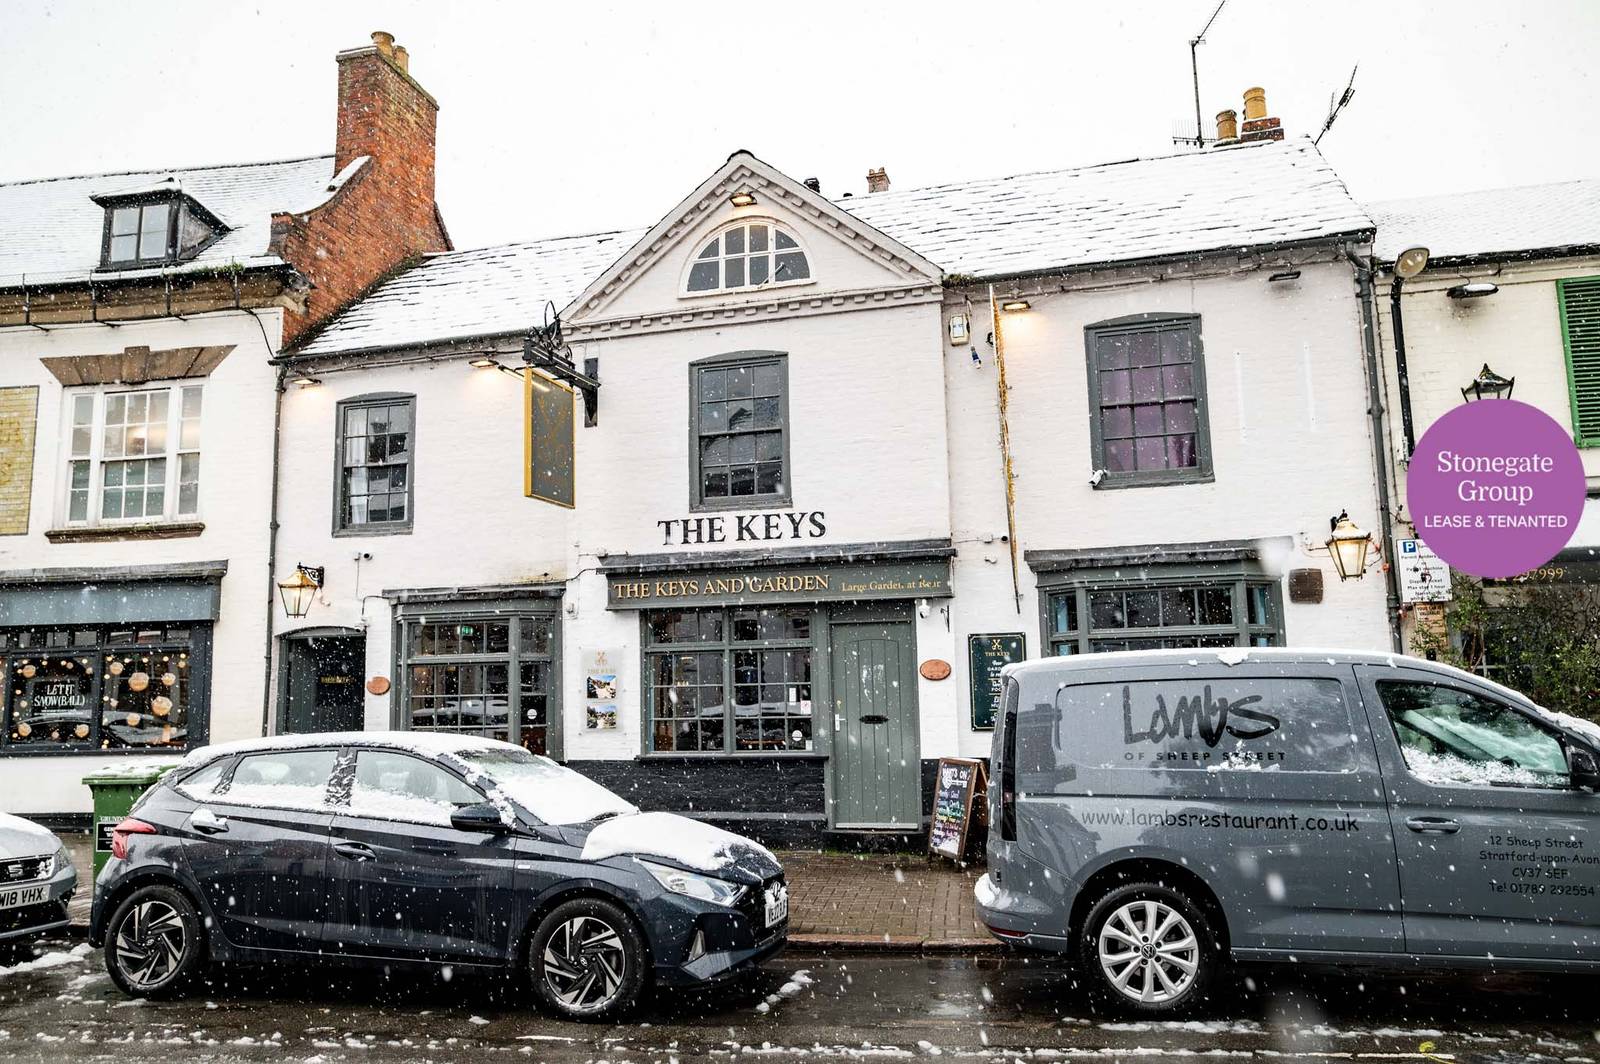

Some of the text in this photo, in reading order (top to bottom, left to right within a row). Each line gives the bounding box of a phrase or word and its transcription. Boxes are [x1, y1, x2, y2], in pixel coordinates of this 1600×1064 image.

[657, 511, 826, 546] THE KEYS
[613, 575, 830, 599] THE KEYS AND GARDEN
[841, 582, 867, 593] Large
[907, 580, 916, 589] at
[46, 684, 76, 696] LET IT
[33, 695, 85, 707] SNOW(BALL)
[1122, 684, 1281, 748] Lambs
[1124, 752, 1145, 761] OF
[1156, 752, 1211, 761] SHEEP
[1081, 807, 1359, 832] www.lambsrestaurant.co.uk
[1489, 835, 1584, 849] 12 Sheep Street
[1480, 851, 1600, 865] Stratford-upon-Avon
[1512, 867, 1542, 878] CV37
[22, 887, 43, 903] VHX
[1510, 883, 1545, 894] 01789
[1550, 884, 1595, 896] 292554
